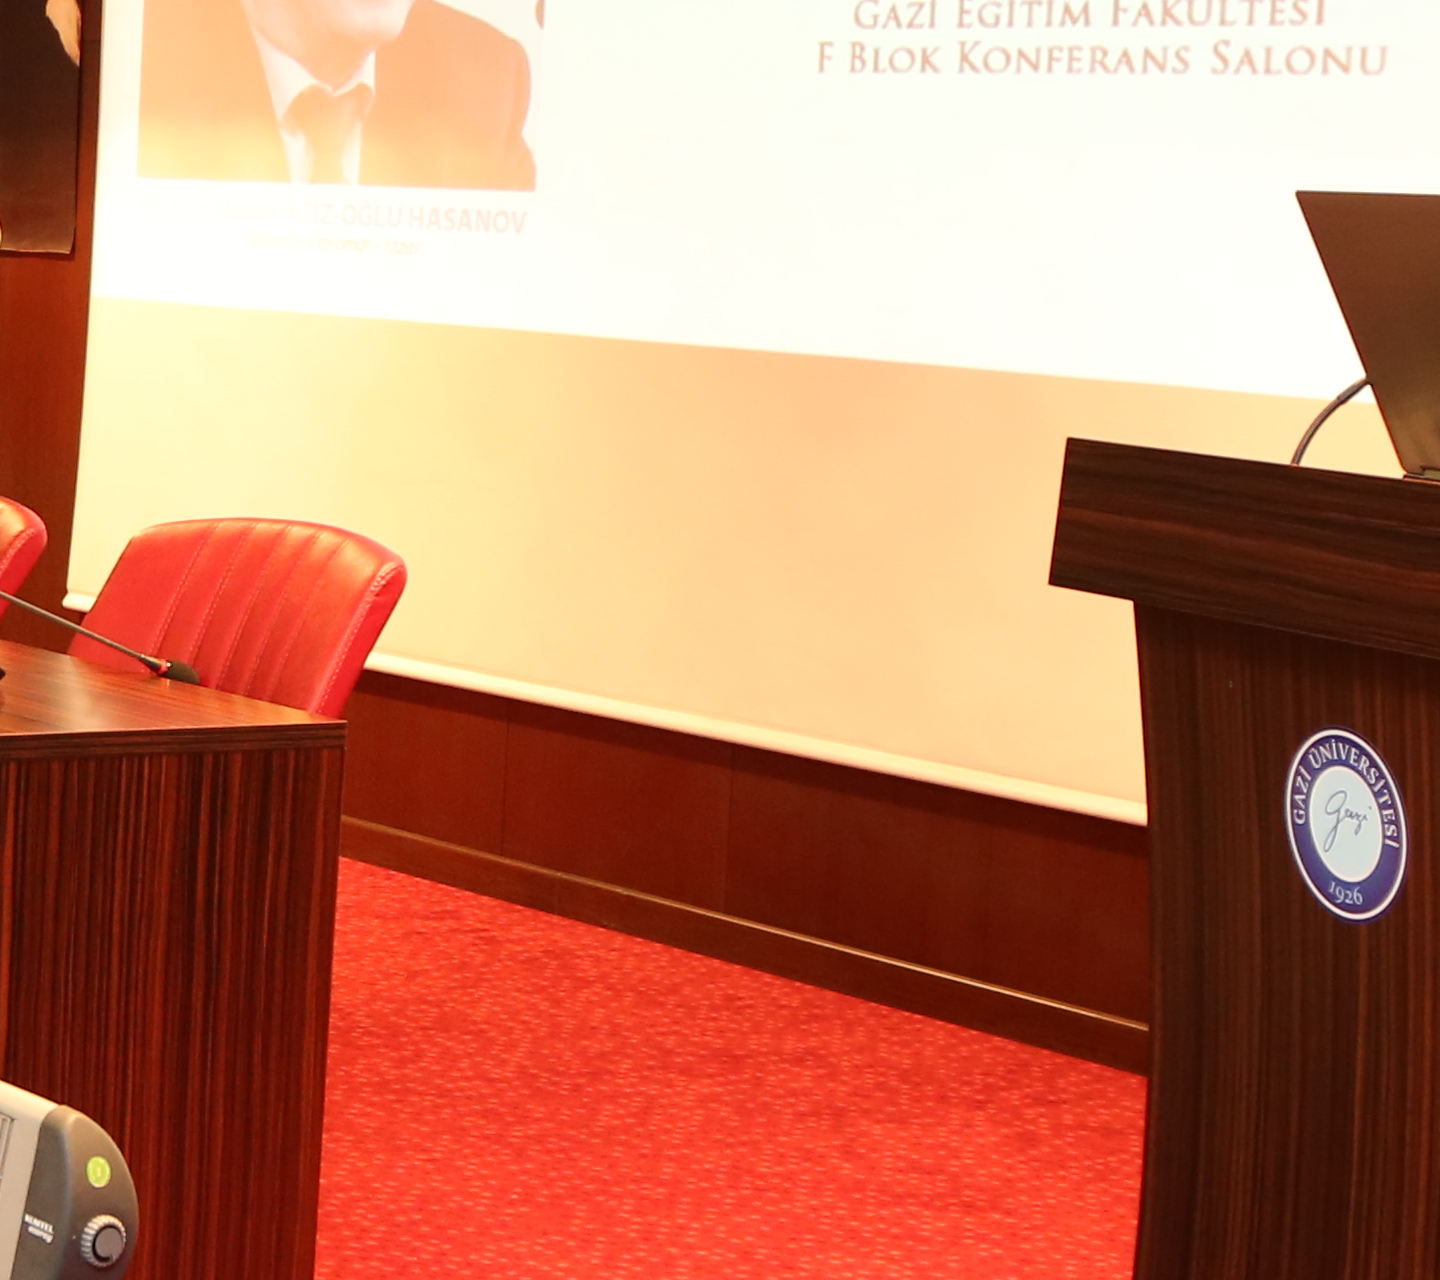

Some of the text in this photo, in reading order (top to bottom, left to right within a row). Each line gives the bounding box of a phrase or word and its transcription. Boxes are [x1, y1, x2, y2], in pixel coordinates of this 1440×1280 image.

[817, 38, 1389, 77] F BLOK KONFERANS SALONU
[407, 205, 529, 235] HASANOV
[1328, 880, 1364, 906] 1926
